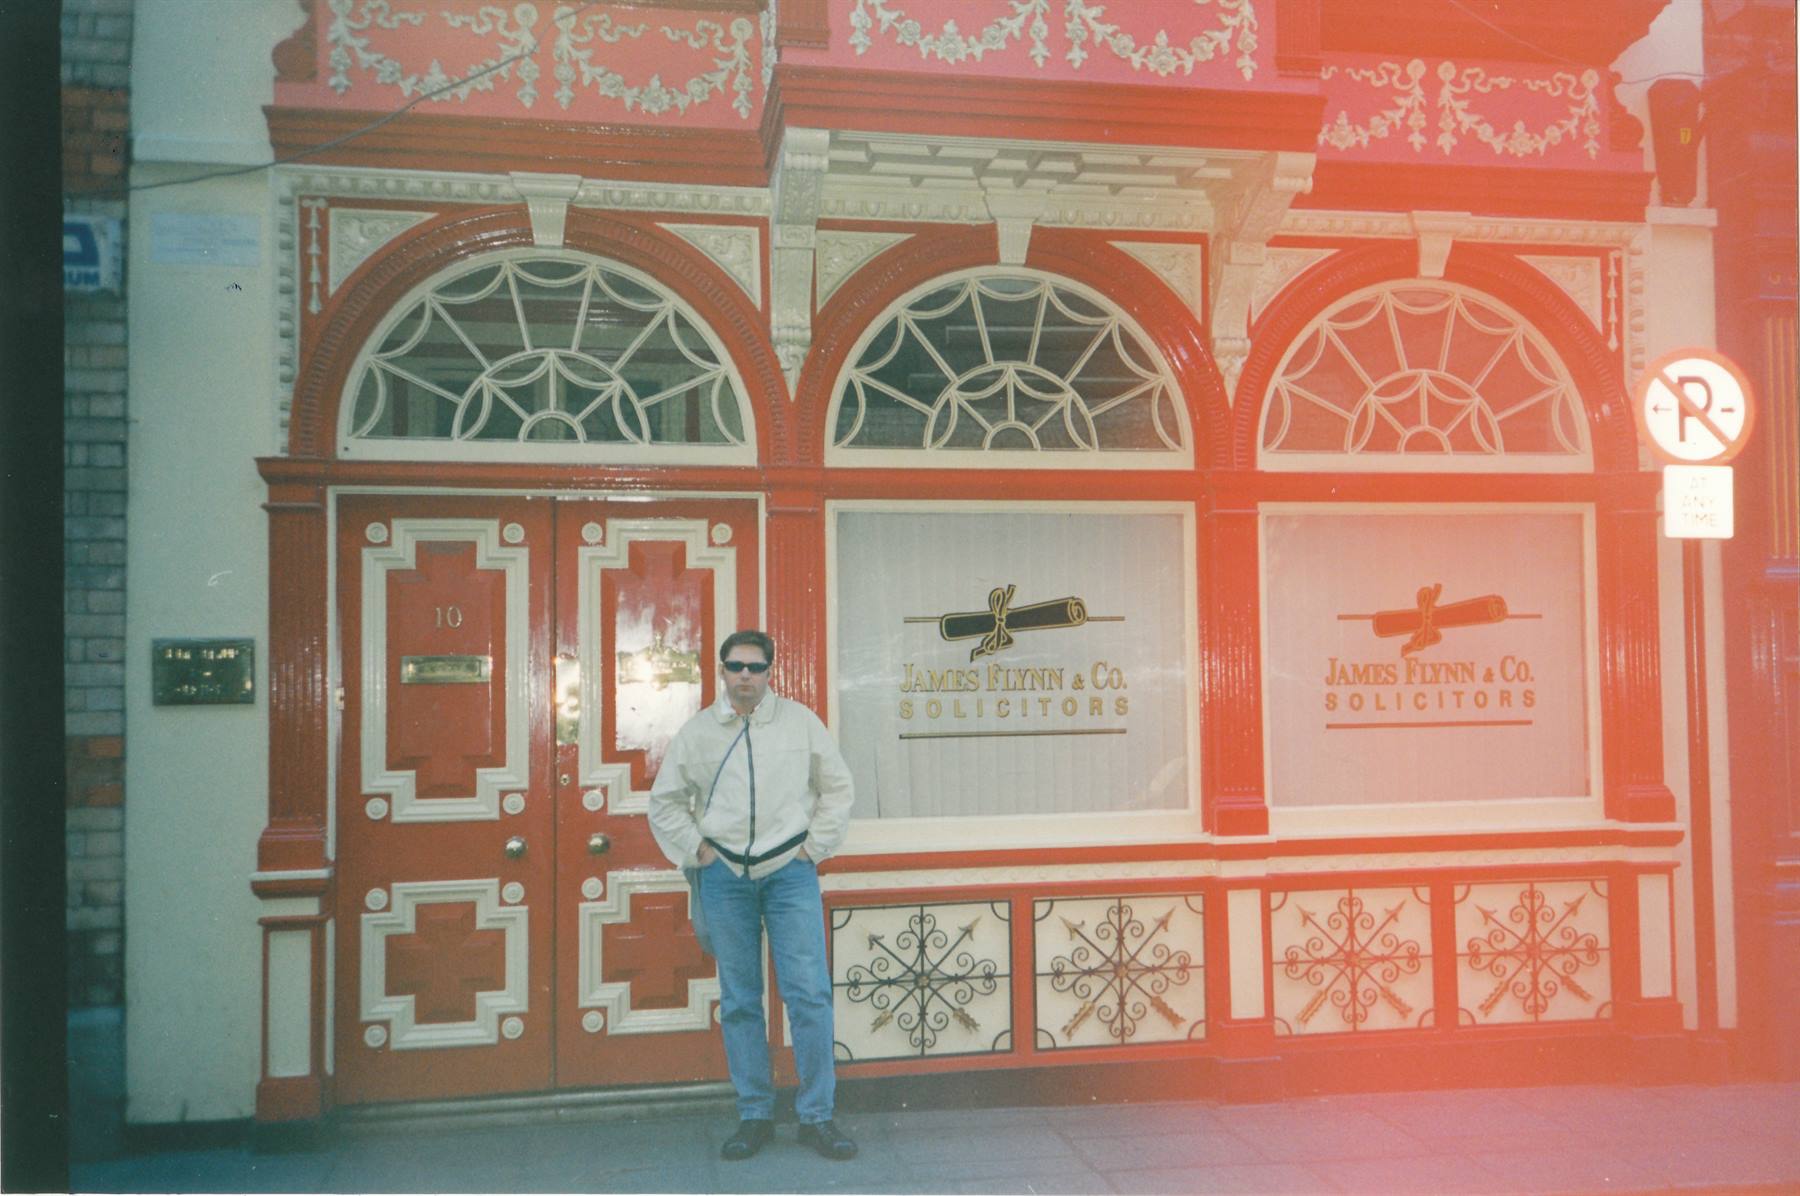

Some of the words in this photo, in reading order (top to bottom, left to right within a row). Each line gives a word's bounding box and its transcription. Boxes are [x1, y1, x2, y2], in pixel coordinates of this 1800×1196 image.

[1677, 375, 1713, 442] P
[1681, 512, 1718, 528] TIME
[436, 607, 462, 628] 10
[900, 663, 979, 692] JAMES
[986, 662, 1064, 691] FLYNN
[1072, 672, 1085, 690] &
[1325, 657, 1398, 686] JAMES
[1404, 656, 1475, 685] FLYNN
[1483, 666, 1494, 683] &
[900, 697, 1129, 719] SOLICITORS
[1325, 689, 1535, 711] SOLICITORS
